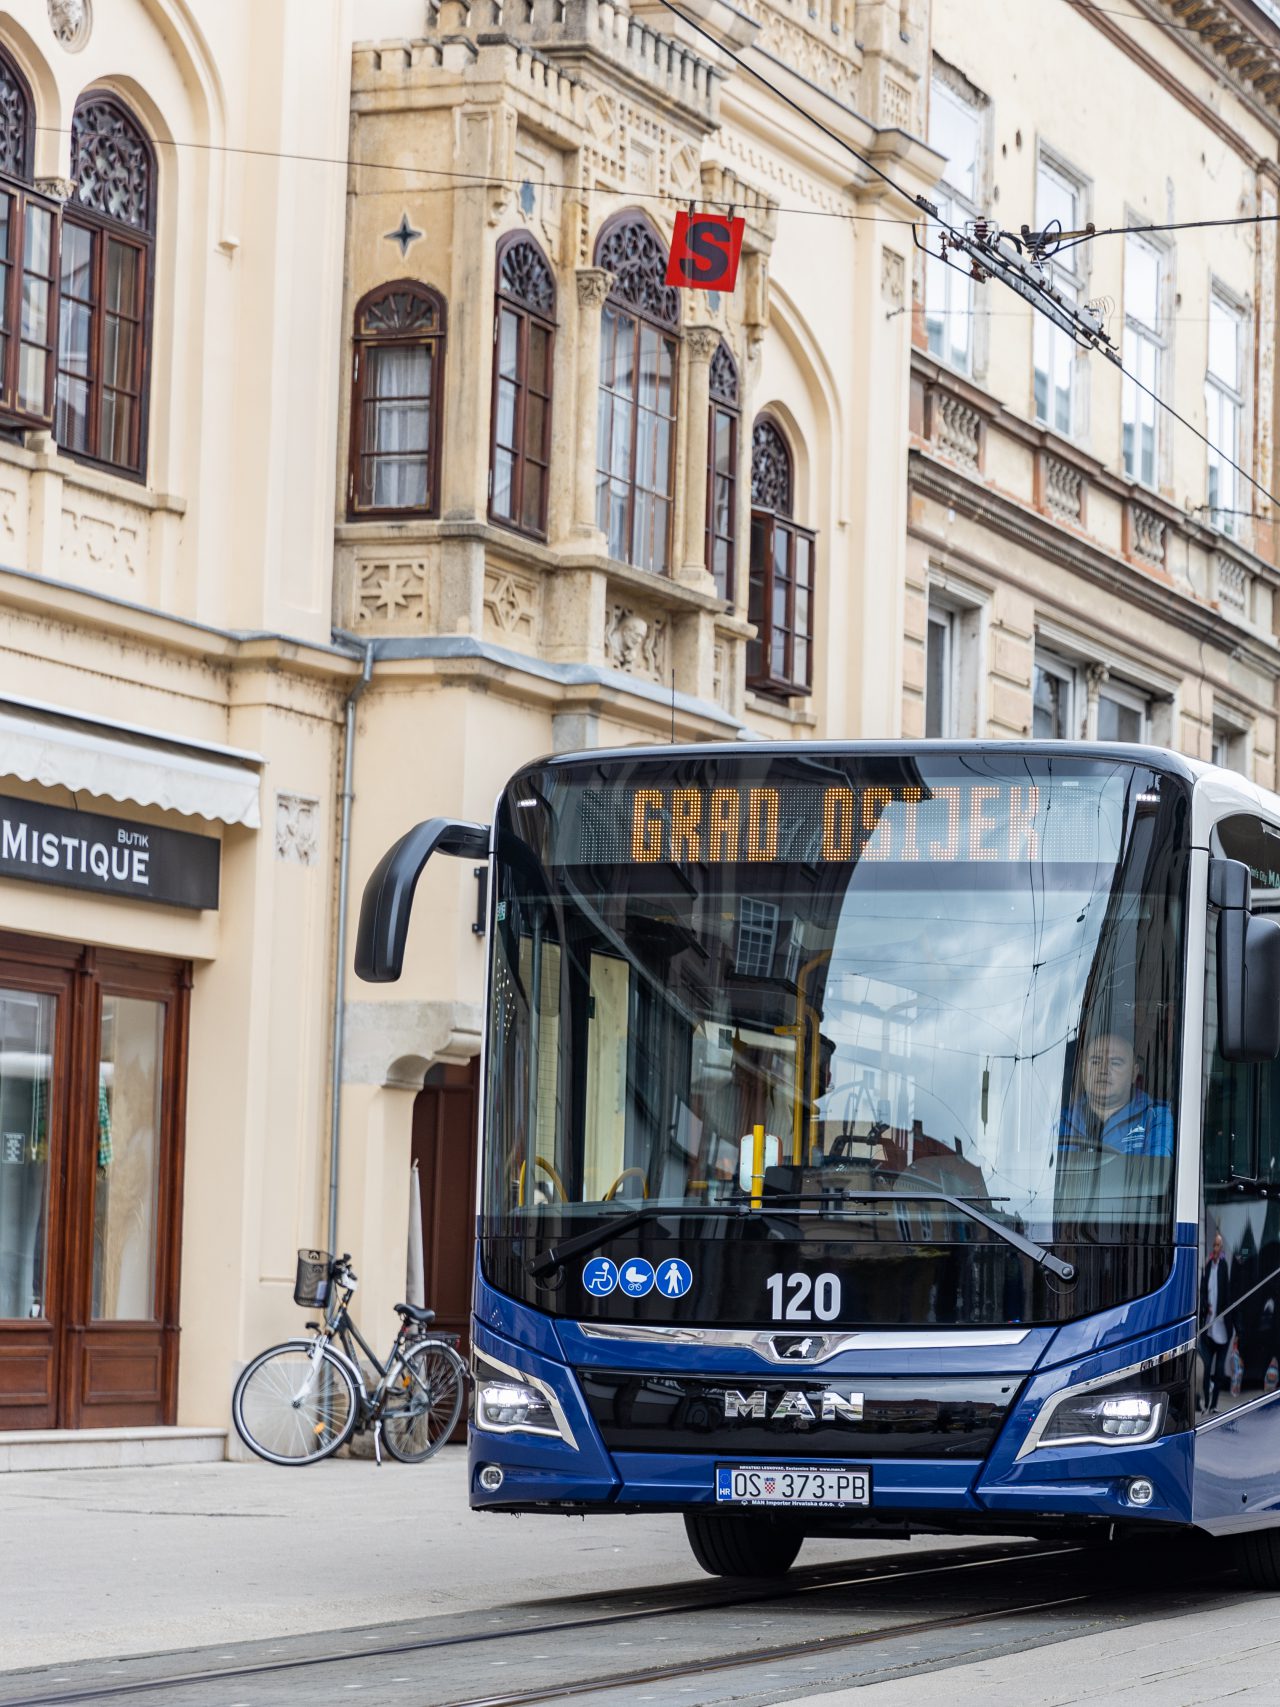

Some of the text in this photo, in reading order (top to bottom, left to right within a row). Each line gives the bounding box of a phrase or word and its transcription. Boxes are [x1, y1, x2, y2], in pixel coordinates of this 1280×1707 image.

[679, 221, 730, 282] S
[117, 828, 149, 848] BUTIK
[631, 786, 1040, 861] GRAD OSIJEK
[2, 819, 150, 885] MISTIQUE
[766, 1272, 841, 1321] 120
[724, 1390, 865, 1421] MAN
[734, 1473, 865, 1499] OS 373-PB
